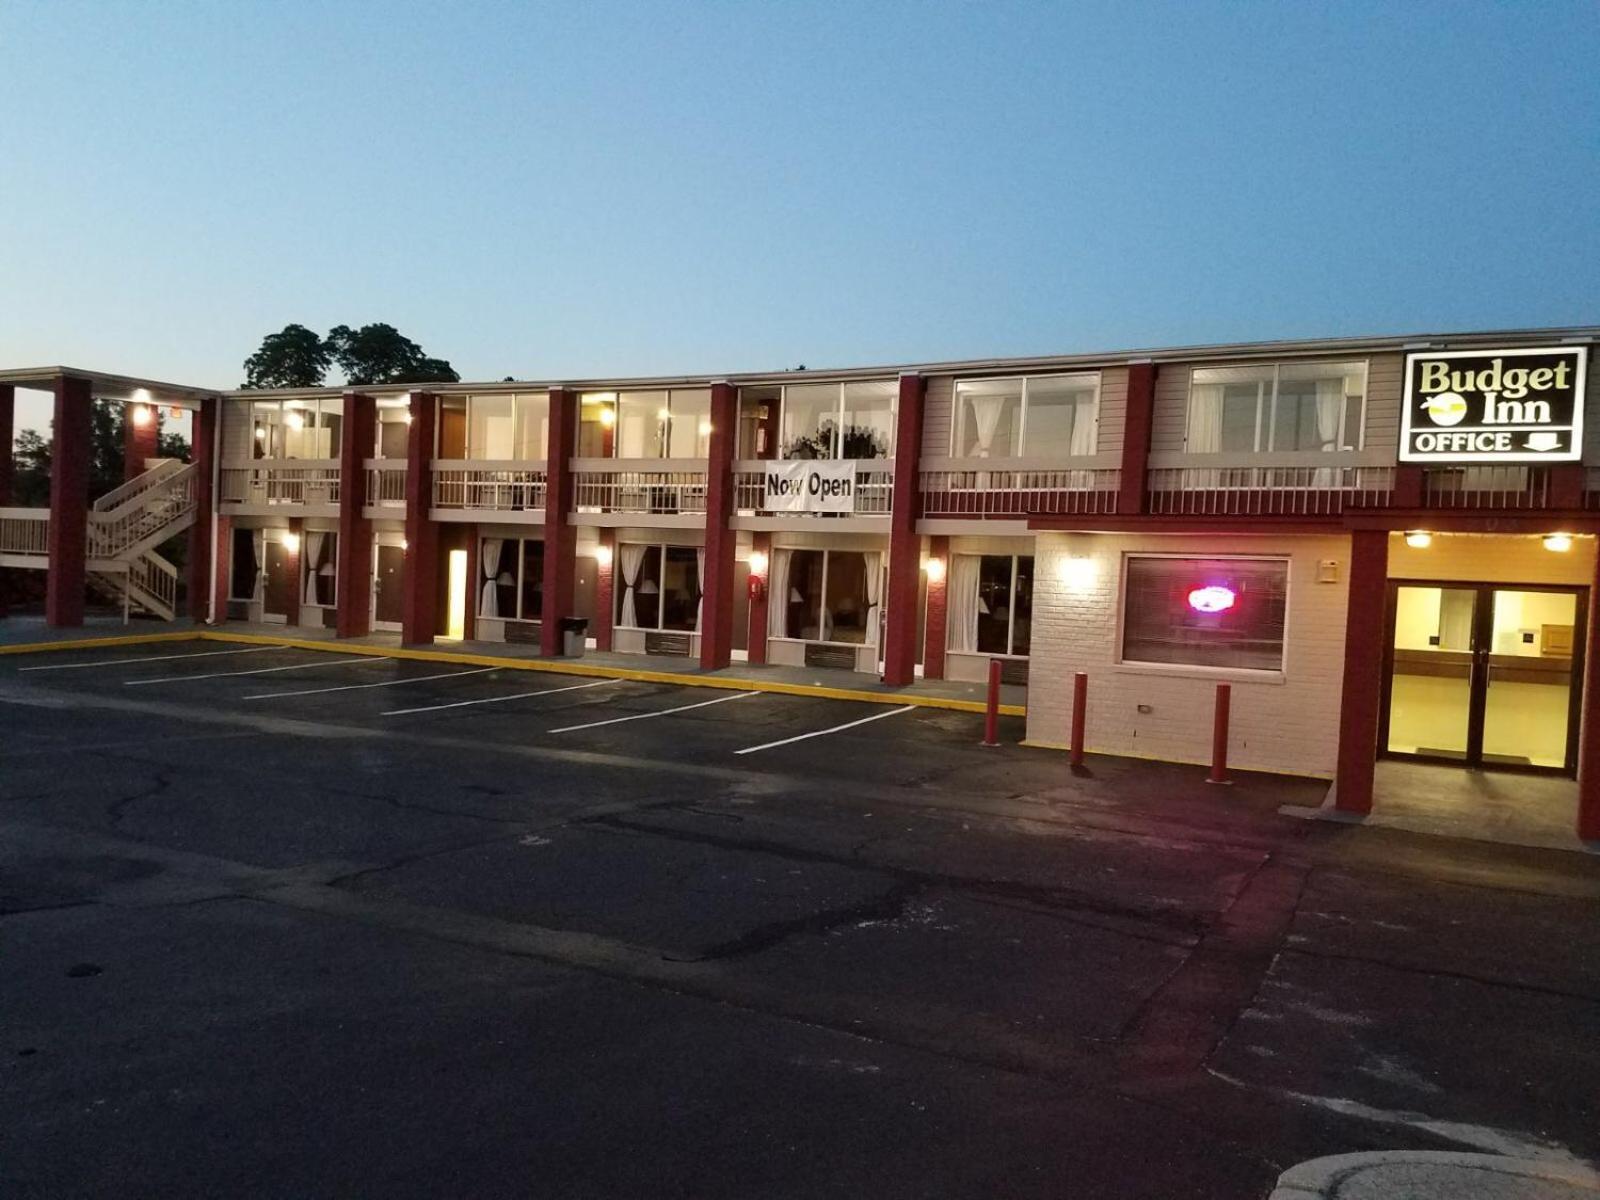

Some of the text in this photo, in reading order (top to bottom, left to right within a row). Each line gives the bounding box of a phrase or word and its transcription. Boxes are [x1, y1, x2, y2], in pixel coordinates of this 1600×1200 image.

[1419, 359, 1570, 398] Budget
[1481, 391, 1550, 423] Inn
[1415, 432, 1512, 452] OFFICE
[767, 472, 851, 501] Now Open
